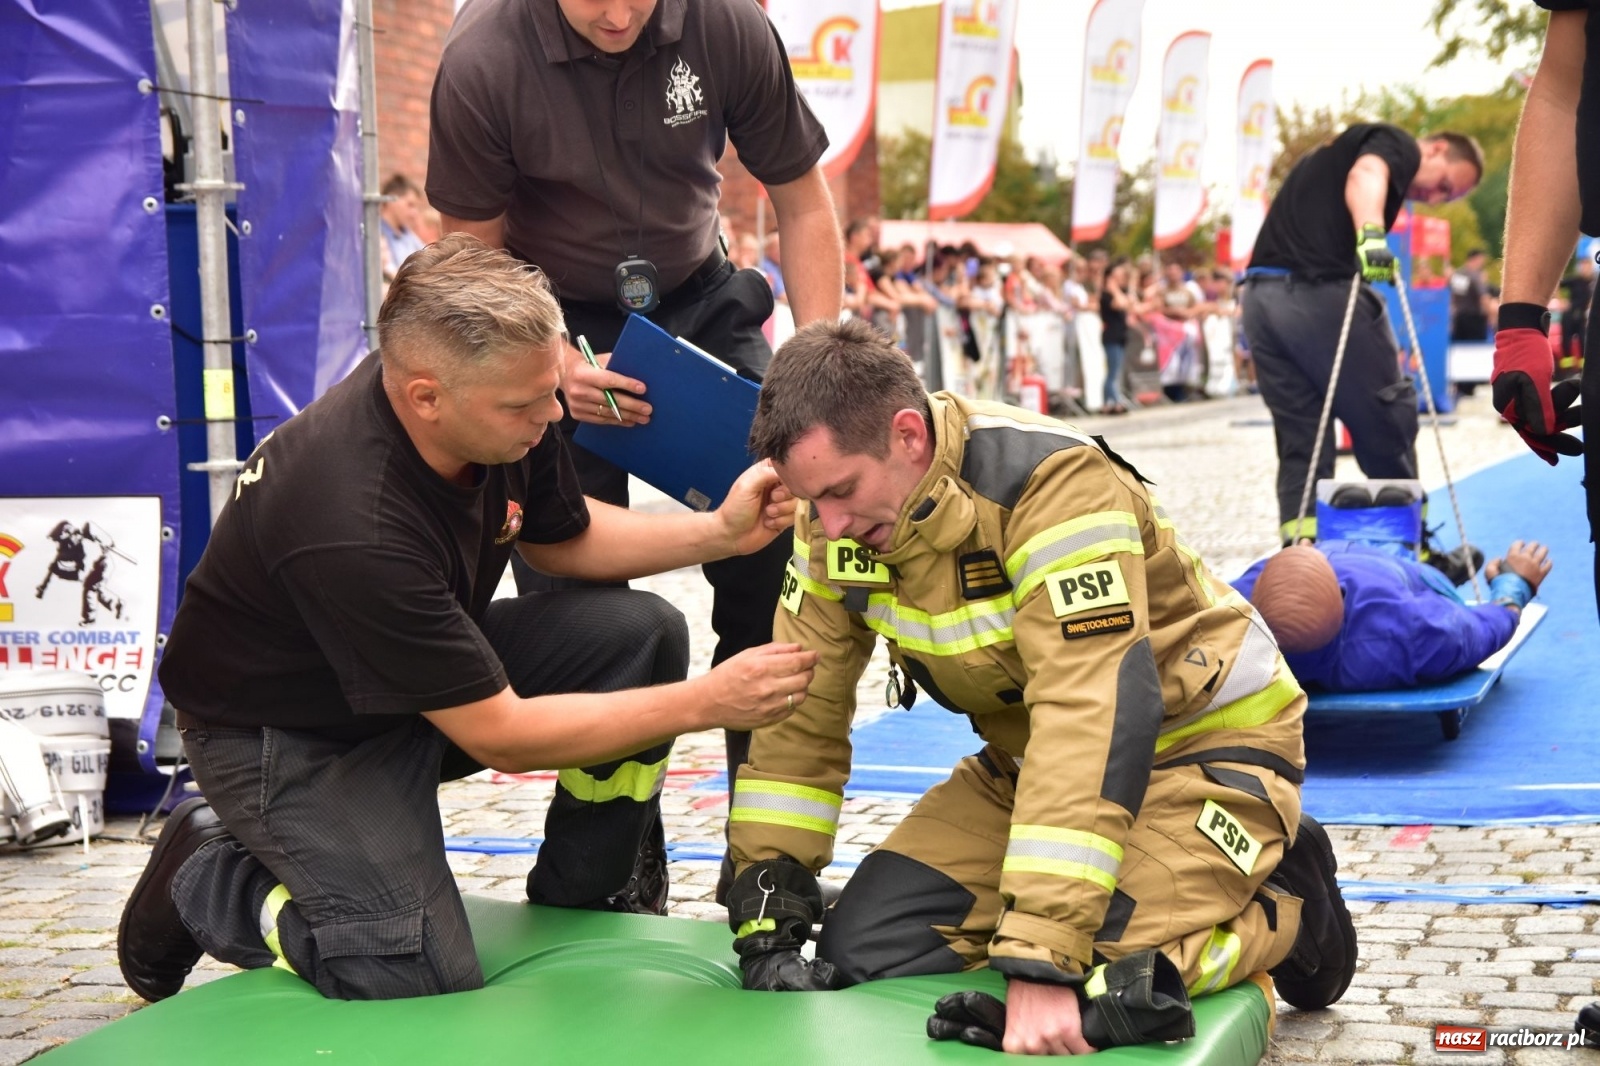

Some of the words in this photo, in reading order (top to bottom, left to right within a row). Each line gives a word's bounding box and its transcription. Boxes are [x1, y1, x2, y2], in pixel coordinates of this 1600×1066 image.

[1058, 569, 1114, 606] PSP
[48, 631, 141, 645] COMBAT
[1208, 809, 1250, 856] PSP
